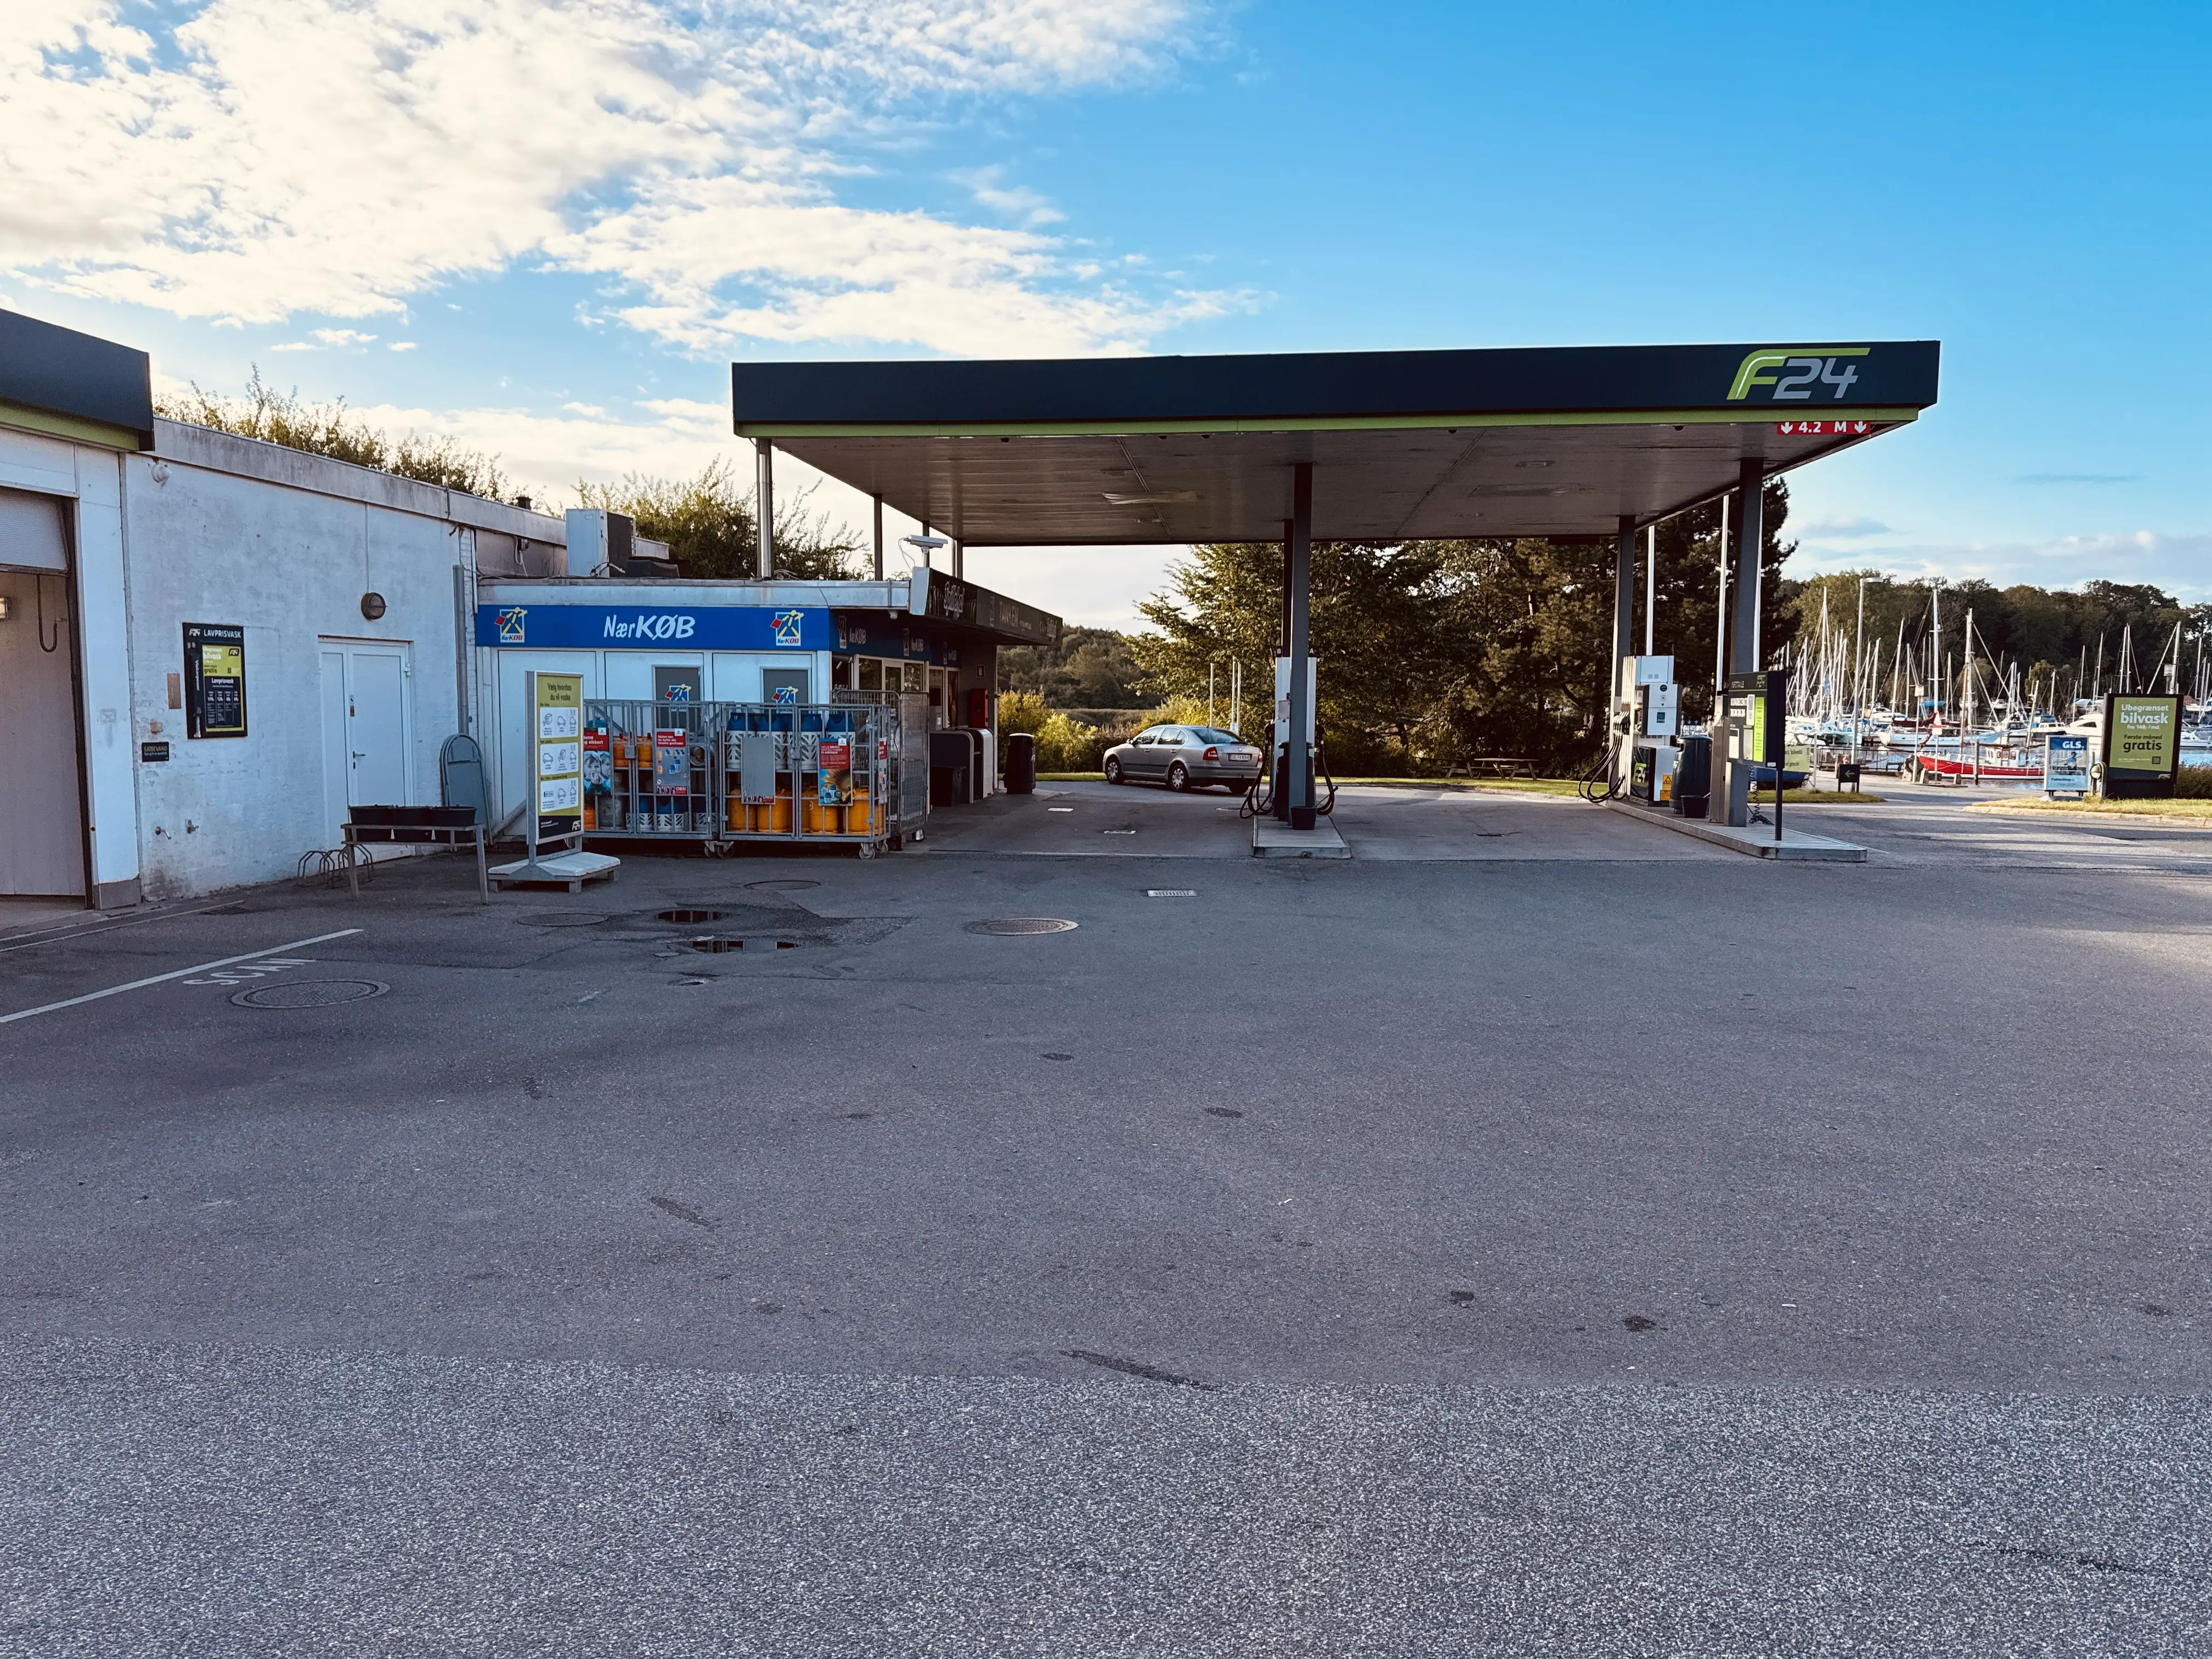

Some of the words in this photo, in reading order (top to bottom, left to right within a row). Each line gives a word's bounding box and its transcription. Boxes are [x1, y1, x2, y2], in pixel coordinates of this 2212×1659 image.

[1726, 347, 1871, 400] F24
[1798, 421, 1821, 433] 4.2
[1834, 421, 1847, 433] M
[603, 614, 696, 640] NærKØB
[204, 629, 241, 638] LAVPRISVASK
[2121, 704, 2169, 712] Ubegrænset
[2120, 712, 2169, 724] bilvask
[2123, 740, 2162, 753] gratis
